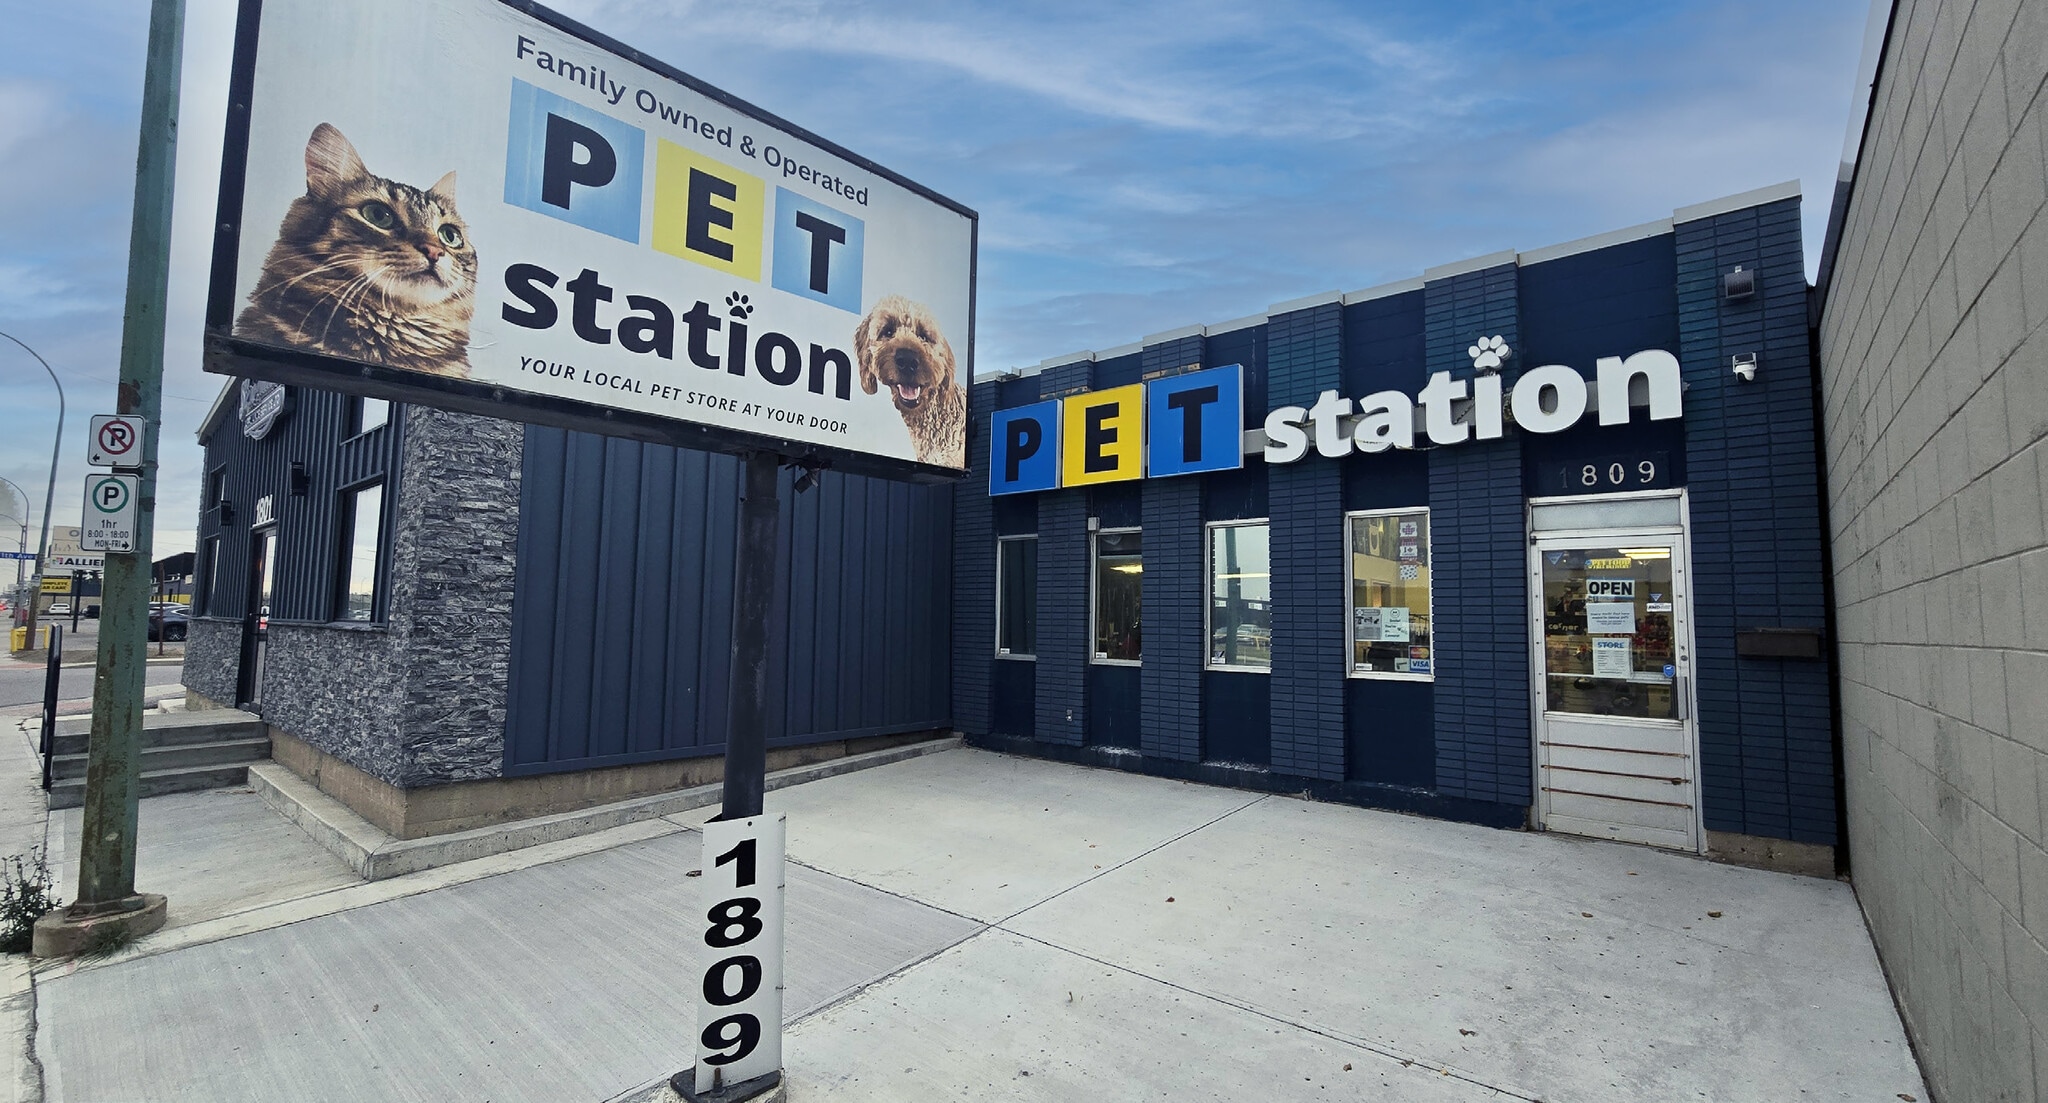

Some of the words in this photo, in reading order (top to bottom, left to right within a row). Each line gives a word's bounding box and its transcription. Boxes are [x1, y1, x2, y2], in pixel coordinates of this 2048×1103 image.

[516, 35, 627, 106] Family
[635, 89, 733, 149] Owned
[739, 135, 757, 159] &
[763, 146, 869, 207] Operated
[541, 112, 846, 296] PET
[501, 263, 852, 402] station
[519, 356, 576, 382] YOUR
[583, 368, 643, 394] LOCAL
[650, 382, 683, 404] PET
[687, 391, 738, 413] STORE
[742, 403, 761, 417] AT
[767, 407, 806, 427] YOUR
[809, 416, 848, 434] DOOR
[1264, 346, 1683, 464] station
[1005, 384, 1219, 482] PET
[1560, 461, 1656, 489] 1809
[104, 486, 119, 506] P
[256, 494, 273, 524] 1801
[87, 530, 104, 538] 8:00
[110, 531, 129, 539] 18:00
[101, 519, 117, 528] 1hr
[94, 540, 121, 548] MON-FRI
[1589, 581, 1633, 596] OPEN
[1597, 641, 1625, 649] STORE
[701, 838, 763, 1066] 1809
